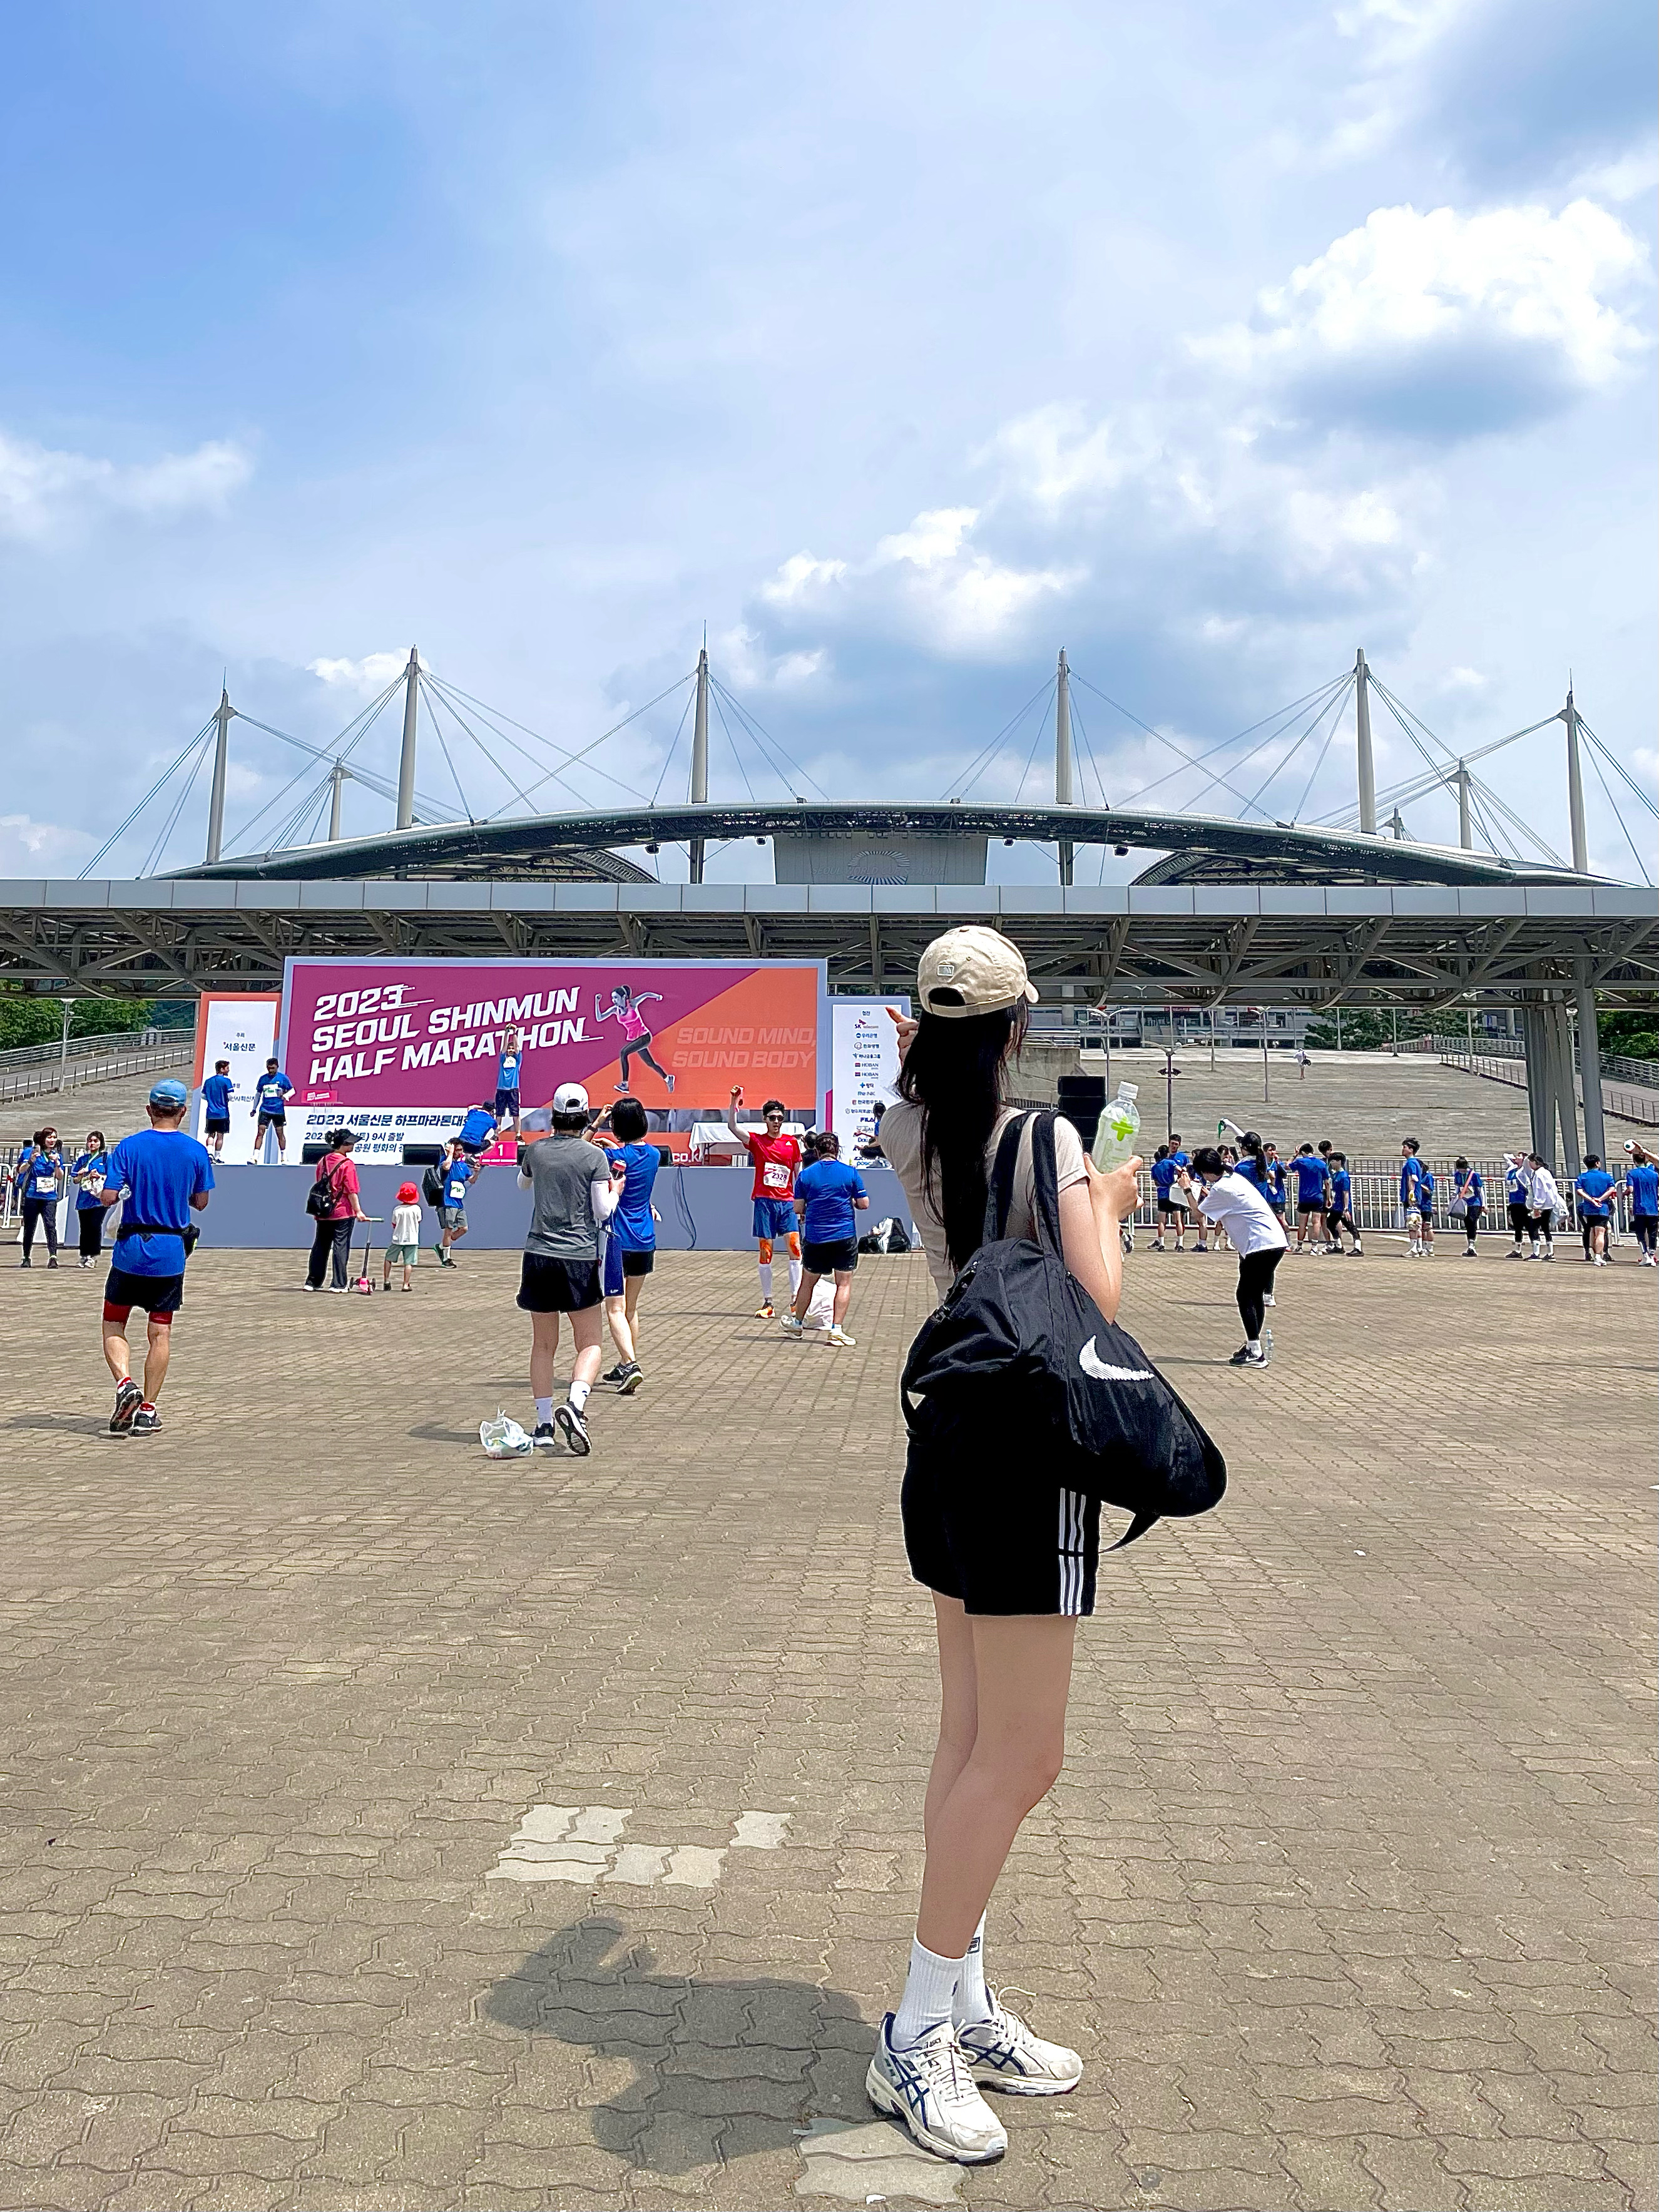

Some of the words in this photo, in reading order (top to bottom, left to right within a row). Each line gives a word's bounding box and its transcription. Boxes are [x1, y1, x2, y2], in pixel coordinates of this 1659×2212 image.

[314, 984, 416, 1021] 2023
[312, 1013, 421, 1059] SEOUL
[427, 986, 581, 1034] SHINMUN
[676, 1027, 755, 1045] SOUND
[757, 1027, 816, 1047] MIND,
[224, 1042, 256, 1051] 서울신문
[309, 1047, 398, 1085] HALF
[401, 1016, 590, 1071] MARATHON
[671, 1051, 750, 1068] SOUND
[752, 1051, 815, 1068] BODY
[307, 1114, 345, 1125] 2023
[346, 1114, 393, 1126] 서울신문
[304, 1132, 326, 1140] 202
[371, 1132, 387, 1141] 9시
[387, 1132, 404, 1141] 출발
[373, 1143, 397, 1153] 평화의
[498, 1144, 504, 1157] 1
[771, 1172, 787, 1181] 2328
